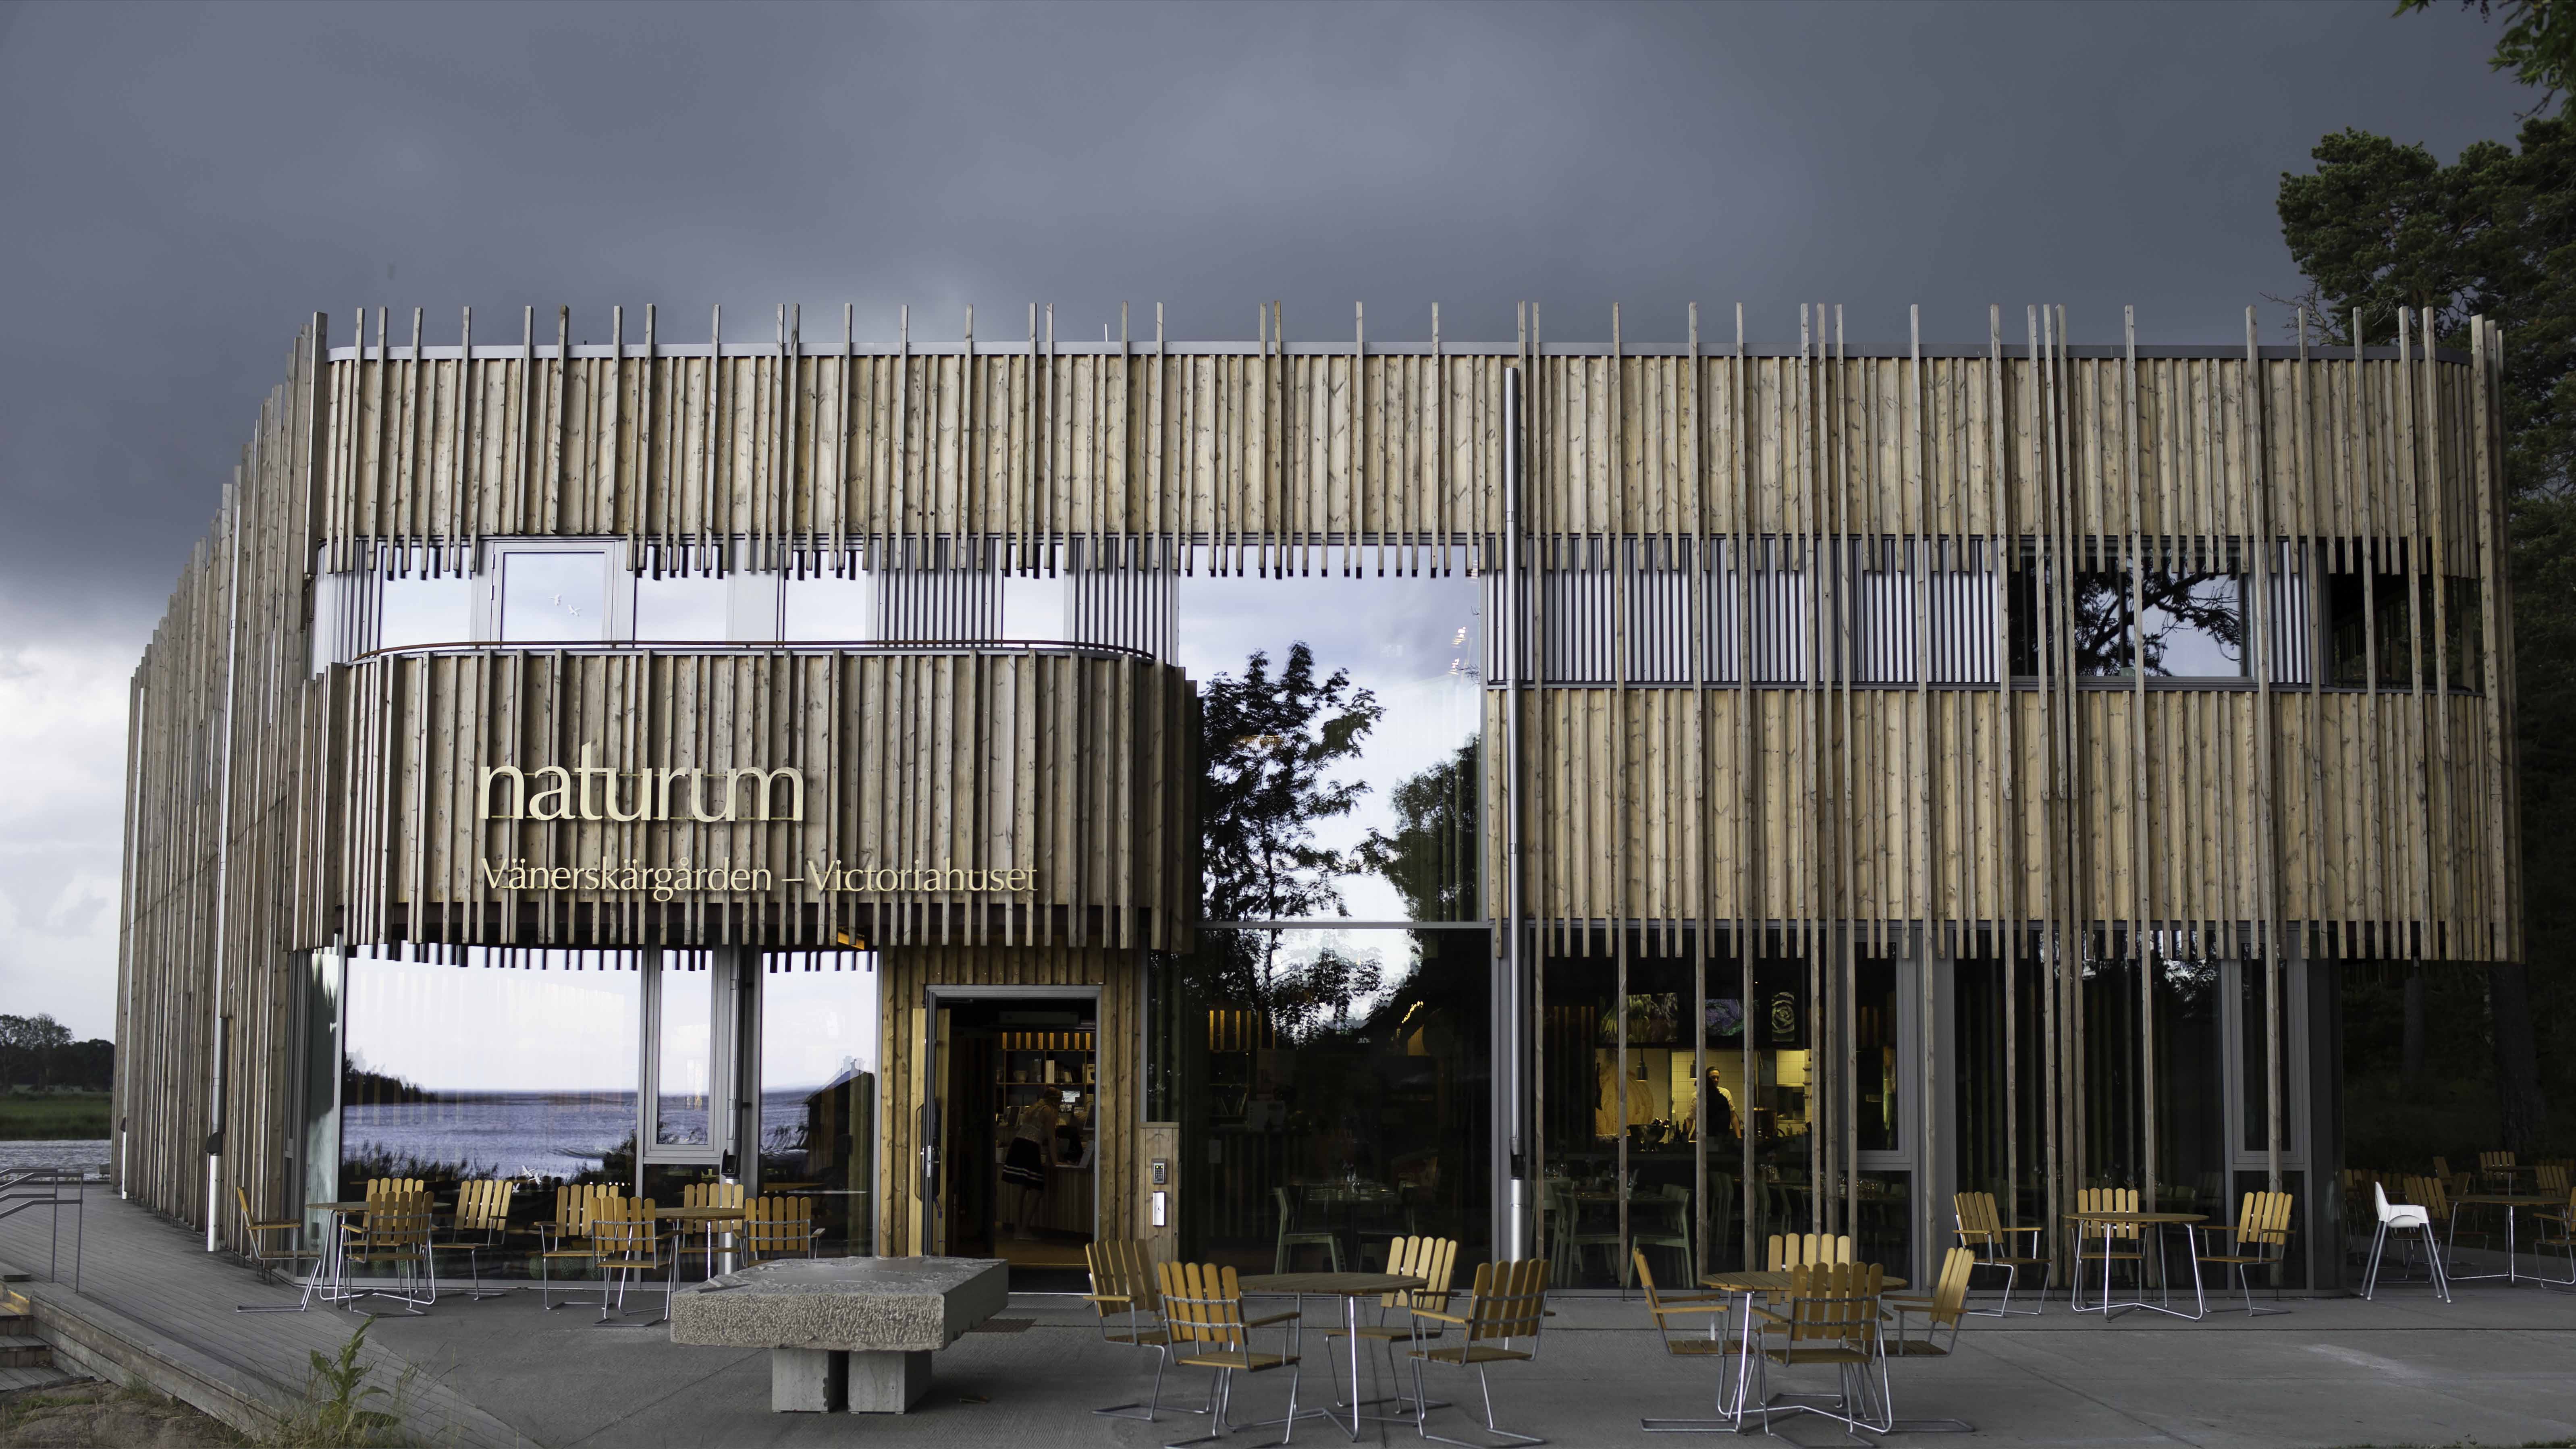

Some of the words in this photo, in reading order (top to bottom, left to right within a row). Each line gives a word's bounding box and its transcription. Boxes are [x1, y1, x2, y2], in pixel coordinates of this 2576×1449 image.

[480, 741, 804, 822] naturum
[481, 856, 771, 902] Vänerskärgården
[808, 857, 1038, 892] Victoriahuset
